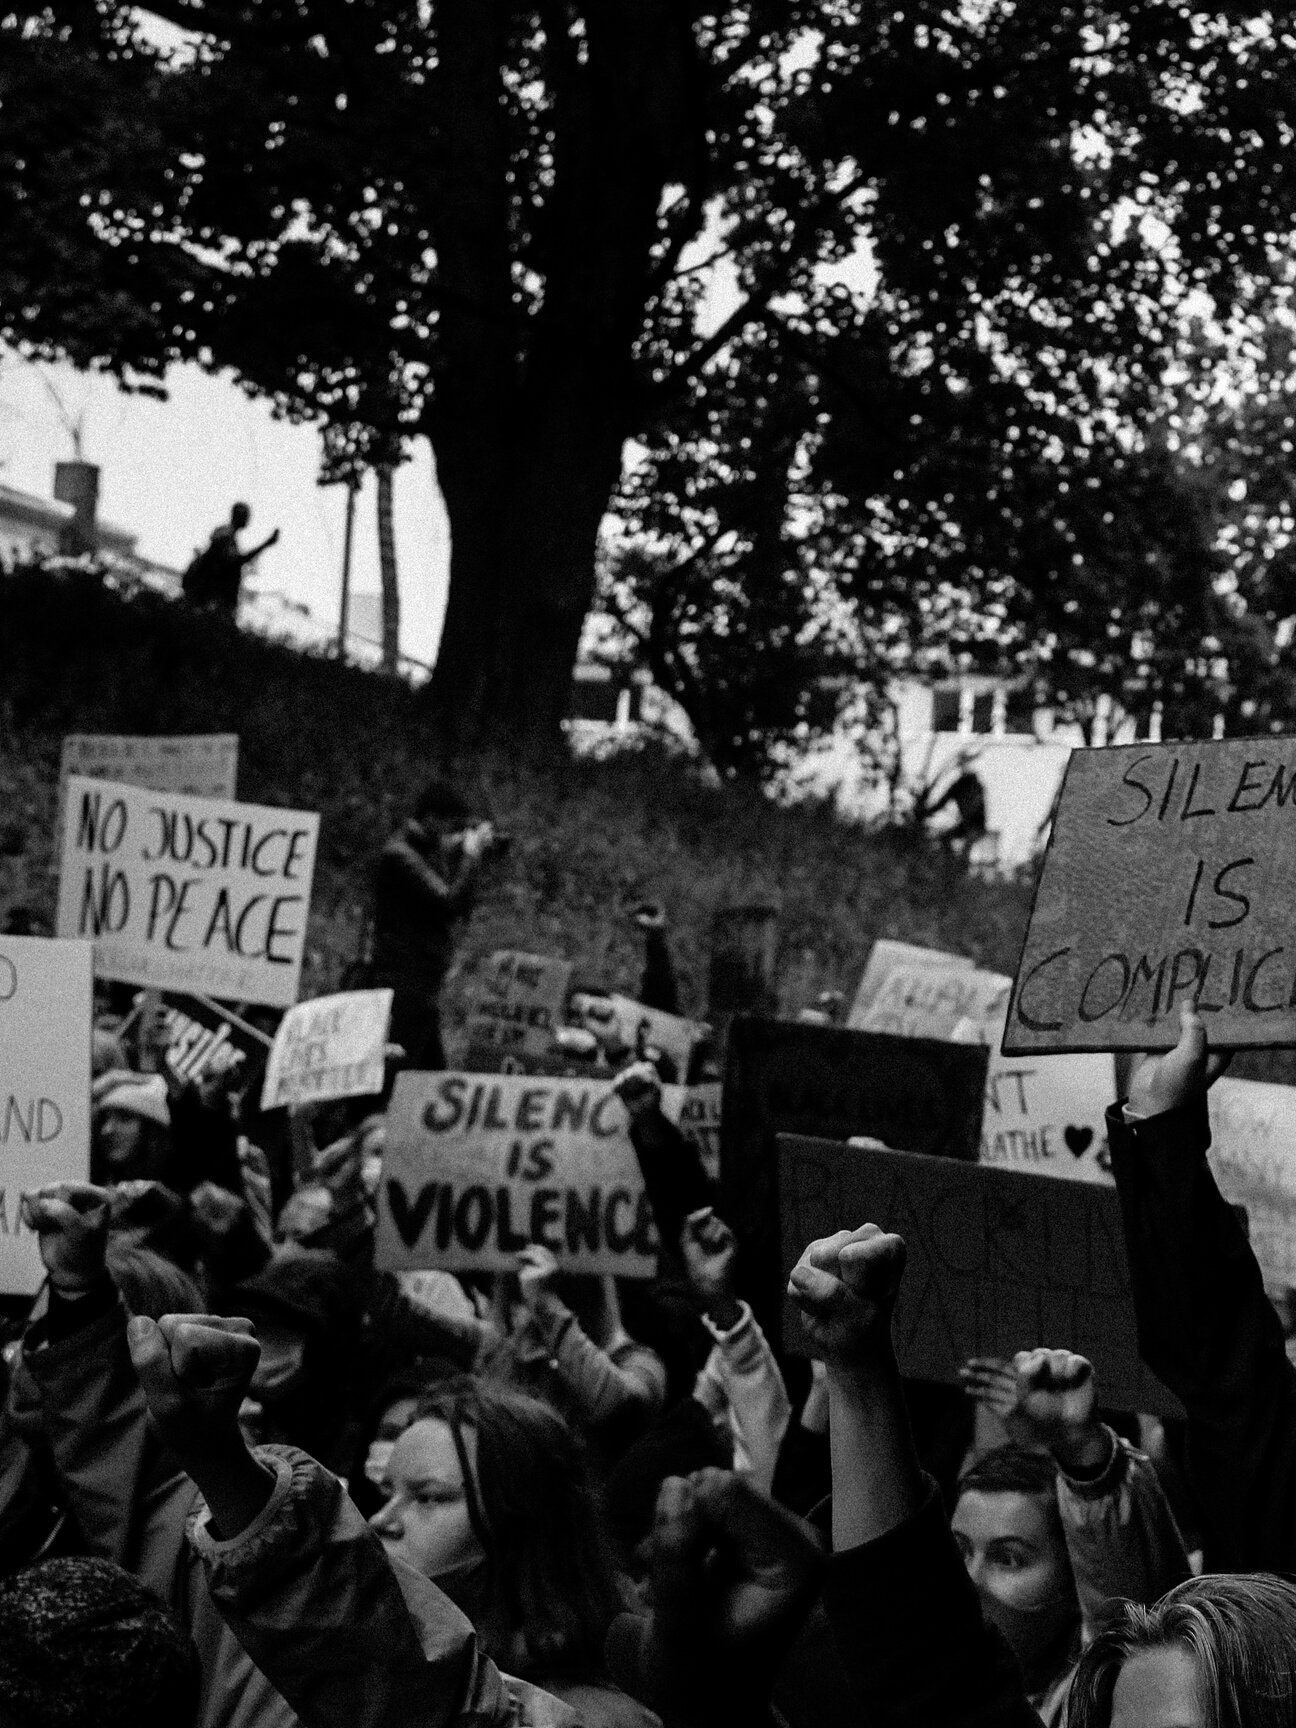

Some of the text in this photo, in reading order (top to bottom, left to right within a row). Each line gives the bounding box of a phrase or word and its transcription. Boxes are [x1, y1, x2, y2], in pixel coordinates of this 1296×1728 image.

[77, 793, 306, 879] NO JUSTICE
[79, 863, 302, 964] NO PEACE
[1184, 857, 1255, 929] IS
[420, 1079, 618, 1138] SILENC
[505, 1141, 551, 1181] IS
